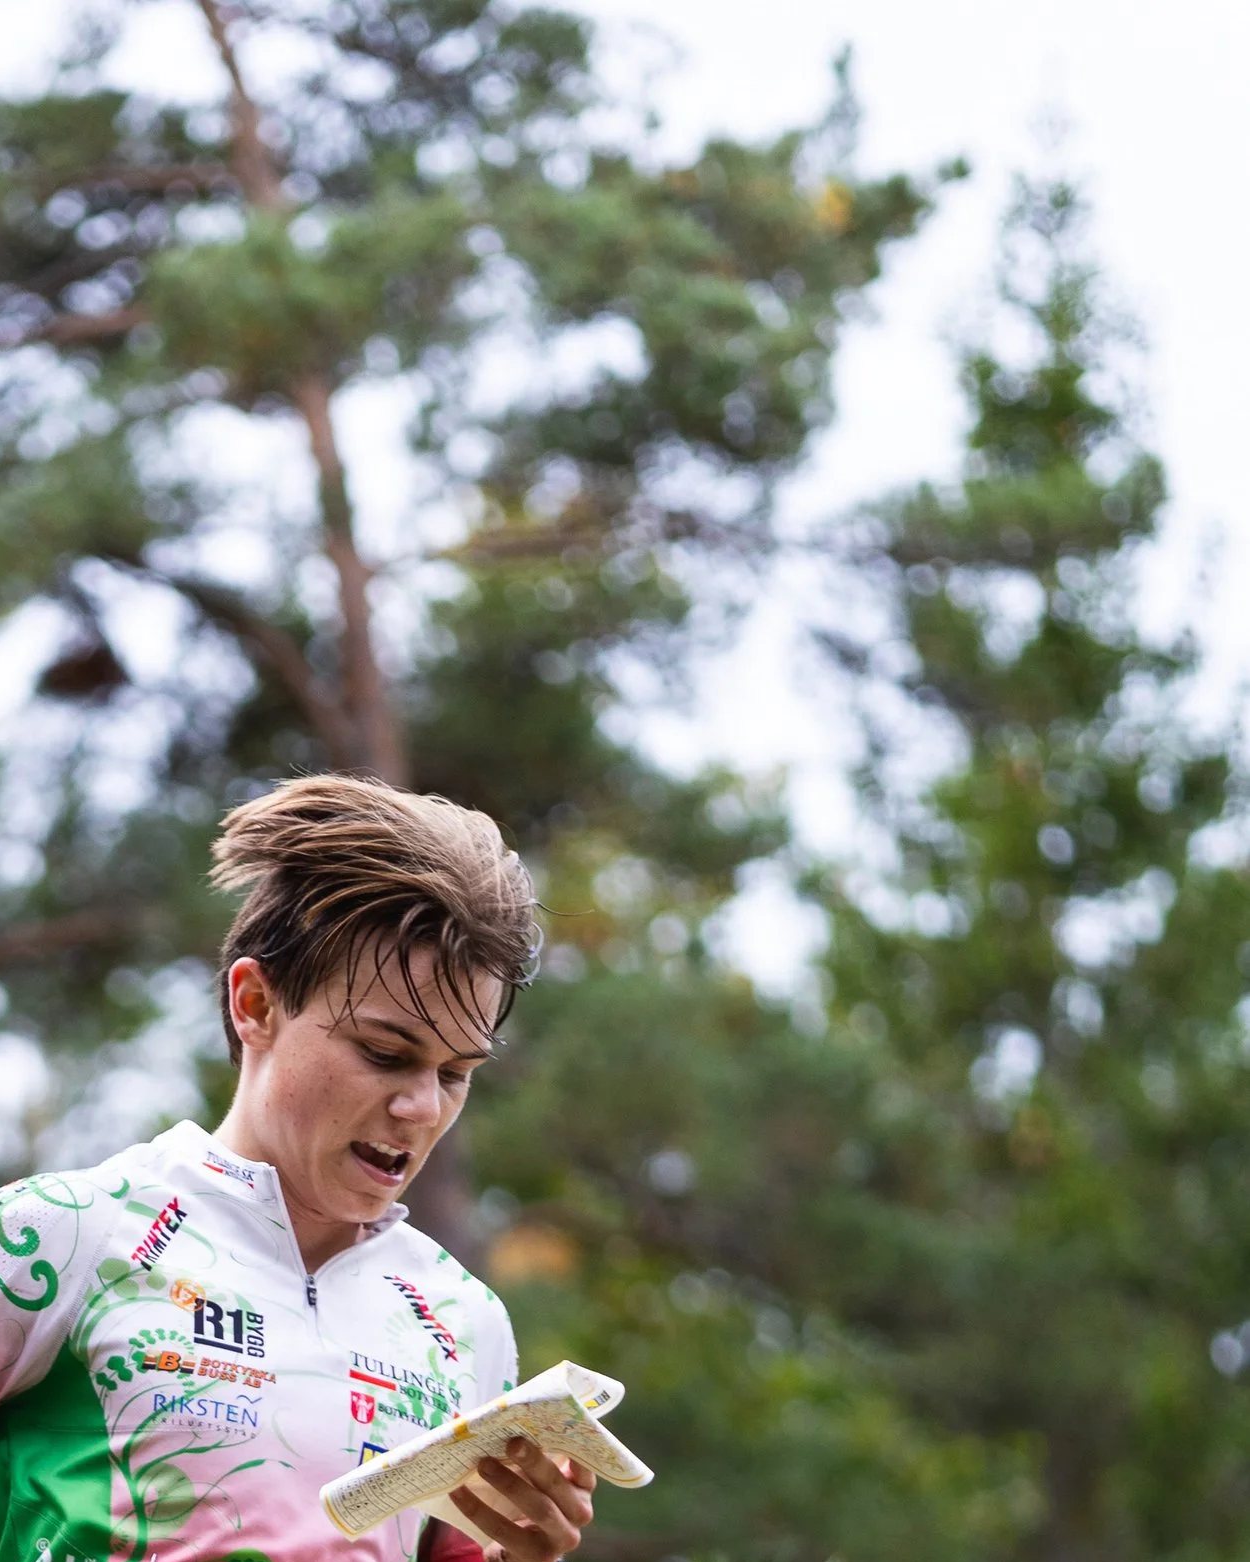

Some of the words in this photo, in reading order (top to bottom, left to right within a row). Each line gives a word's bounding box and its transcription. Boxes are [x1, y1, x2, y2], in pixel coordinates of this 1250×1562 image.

[131, 1196, 187, 1272] TRIMTEX
[194, 1297, 243, 1345] R1
[246, 1311, 265, 1359] BYGG
[382, 1275, 459, 1362] TRIMTEX
[198, 1367, 237, 1383] BUSS
[243, 1376, 262, 1388] AB
[199, 1357, 277, 1384] BOTKYRKA
[350, 1350, 446, 1398] TULLINGE
[153, 1393, 258, 1428] RIKSTEN
